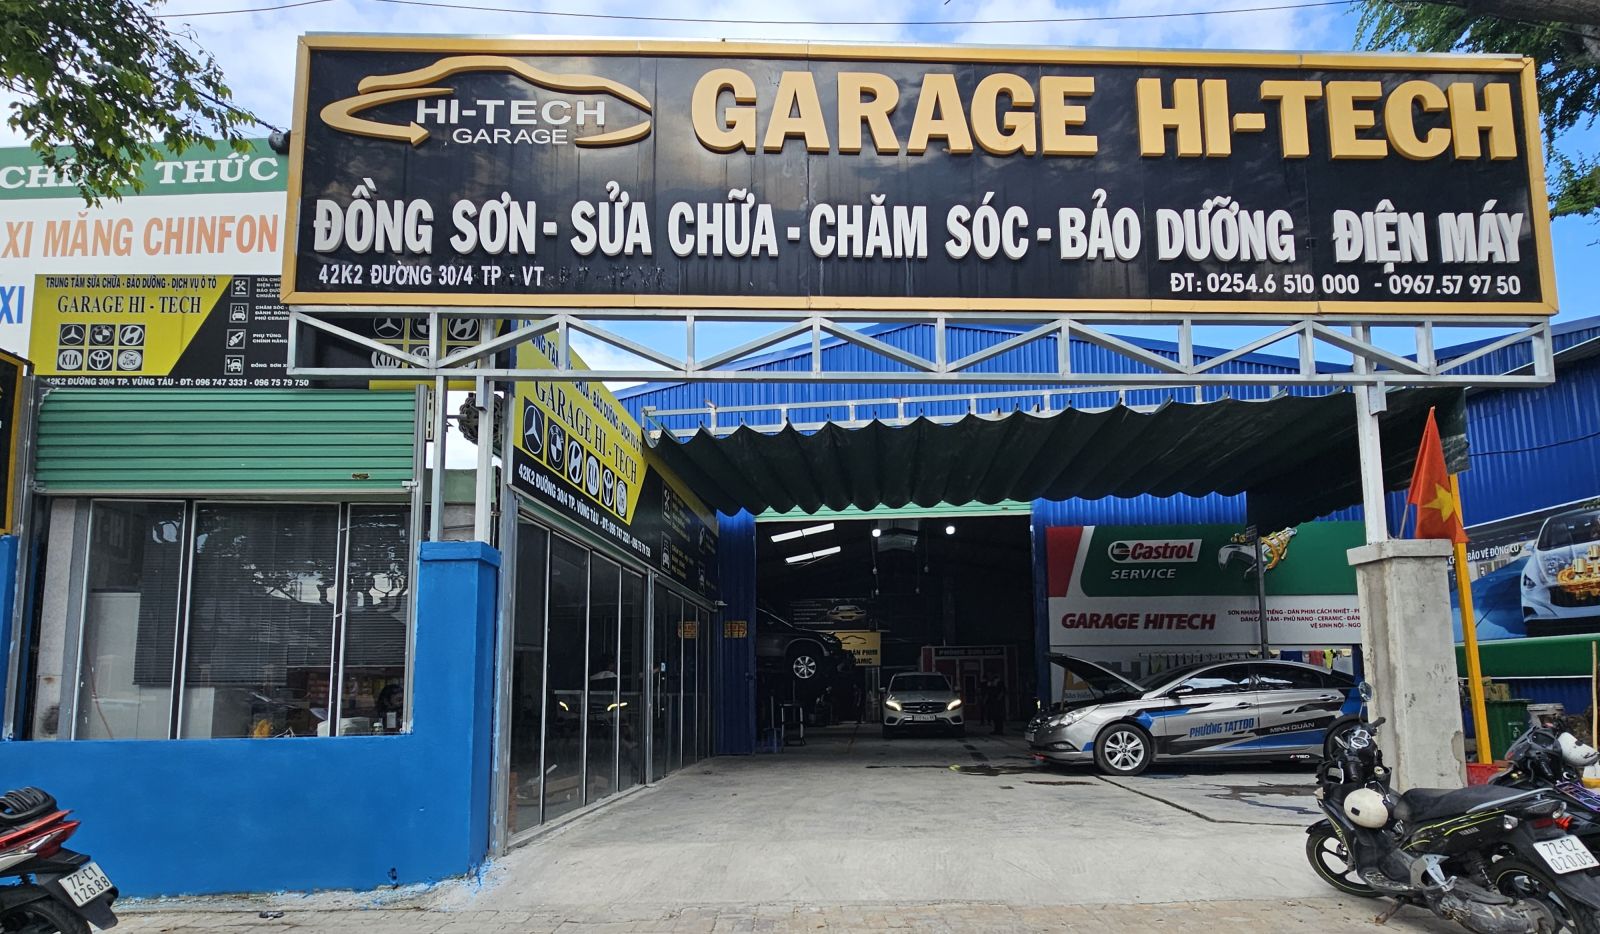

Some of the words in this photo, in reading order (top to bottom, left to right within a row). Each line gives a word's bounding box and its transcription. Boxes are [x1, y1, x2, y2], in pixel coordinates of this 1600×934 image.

[416, 100, 605, 124] HI-TECH
[691, 68, 1098, 156] GARAGE
[1136, 78, 1518, 160] HI-TECH
[452, 128, 568, 144] GARAGE
[154, 153, 278, 184] THỨC
[2, 222, 34, 258] XI
[43, 212, 132, 257] MĂNG
[143, 214, 278, 256] CHINFON
[314, 178, 434, 254] ĐỒNG
[450, 192, 536, 254] SƠN
[570, 180, 652, 256] SỬA
[668, 188, 778, 258] CHỮA
[810, 194, 928, 258] CHĂM
[945, 192, 1028, 260] SÓC
[1058, 188, 1141, 262] BẢO
[1156, 196, 1296, 262] DƯỠNG
[1332, 199, 1428, 274] ĐIỆN
[1438, 200, 1524, 264] MÁY
[318, 264, 362, 284] 42K2
[370, 260, 432, 286] ĐƯỜNG
[438, 265, 473, 286] 30/4
[481, 266, 501, 286] TP
[522, 266, 544, 286] VT
[46, 277, 68, 288] TRUNG
[71, 275, 85, 288] TÂM
[87, 275, 100, 288] SỬA
[102, 275, 120, 288] CHỮA
[126, 274, 140, 288] BẢO
[142, 275, 166, 288] DƯỠNG
[172, 277, 188, 292] DỊCH
[190, 277, 198, 292] VỤ
[201, 275, 205, 289] Ô
[208, 275, 216, 289] TÔ
[1170, 273, 1201, 292] ĐT:
[1207, 273, 1276, 294] 0254.6
[1284, 274, 1314, 294] 510
[1322, 274, 1360, 294] 000
[1389, 274, 1462, 294] 0967.57
[1469, 276, 1491, 294] 97
[1497, 276, 1520, 294] 50
[58, 295, 124, 313] GARAGE
[128, 296, 145, 313] HI
[158, 296, 201, 313] TECH
[62, 354, 78, 366] KIA
[132, 376, 155, 386] VŨNG
[535, 381, 592, 444] GARAGE
[595, 424, 606, 457] HI
[614, 443, 637, 484] TECH
[519, 464, 535, 485] 42K2
[556, 487, 568, 505] 30/4
[568, 495, 576, 511] TP.
[1131, 542, 1194, 560] Castrol
[1467, 550, 1480, 561] BẢO
[1110, 569, 1176, 579] SERVICE
[1061, 613, 1140, 630] GARAGE
[1144, 614, 1216, 630] HITECH
[1224, 718, 1255, 732] TATTOO
[1543, 838, 1578, 856] 72-C2
[1550, 852, 1594, 871] 020.05
[67, 866, 100, 889] 72-C1
[74, 876, 110, 903] 126.88
